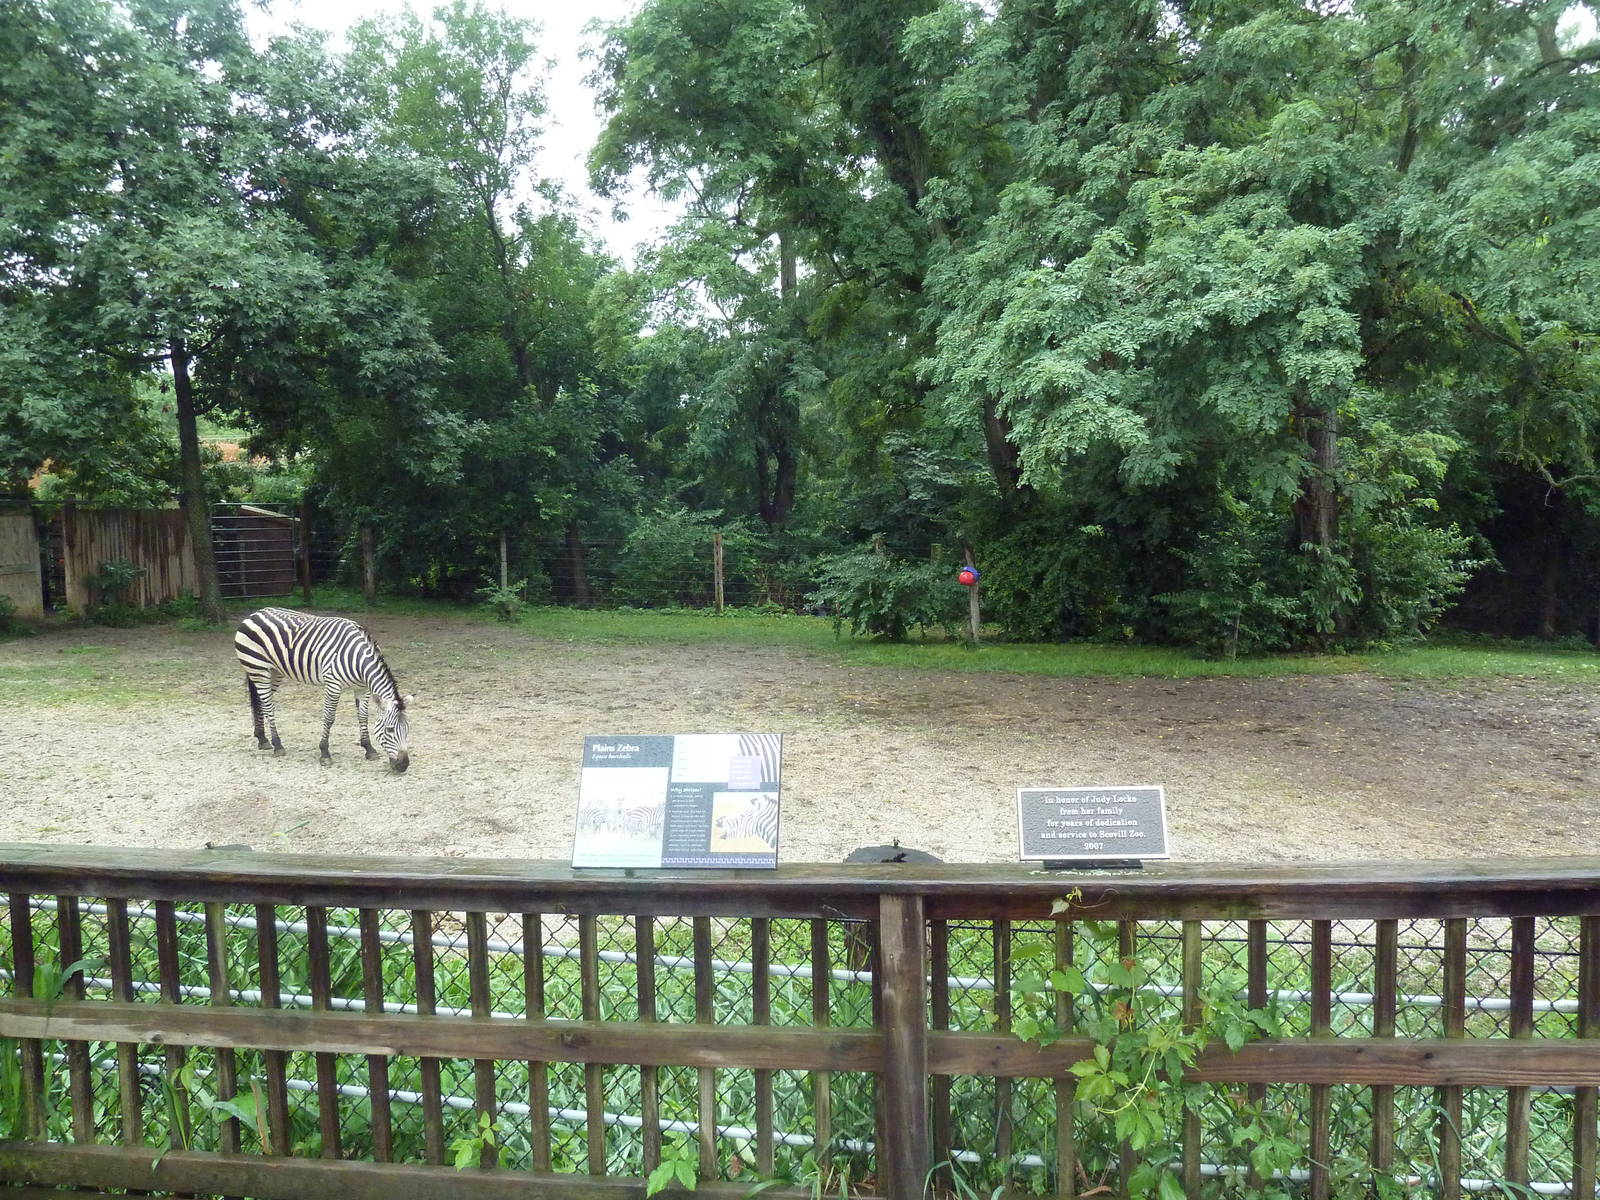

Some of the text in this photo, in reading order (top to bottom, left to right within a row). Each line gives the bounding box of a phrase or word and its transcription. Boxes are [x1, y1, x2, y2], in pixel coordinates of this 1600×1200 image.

[593, 744, 640, 752] Plains Zebra
[1045, 795, 1137, 804] In honor of Judy Locke
[1060, 806, 1123, 816] from her family
[1047, 819, 1138, 828] for years of dedication
[1040, 829, 1146, 839] and service to Scovill Zoo.
[1084, 842, 1104, 850] 2007
